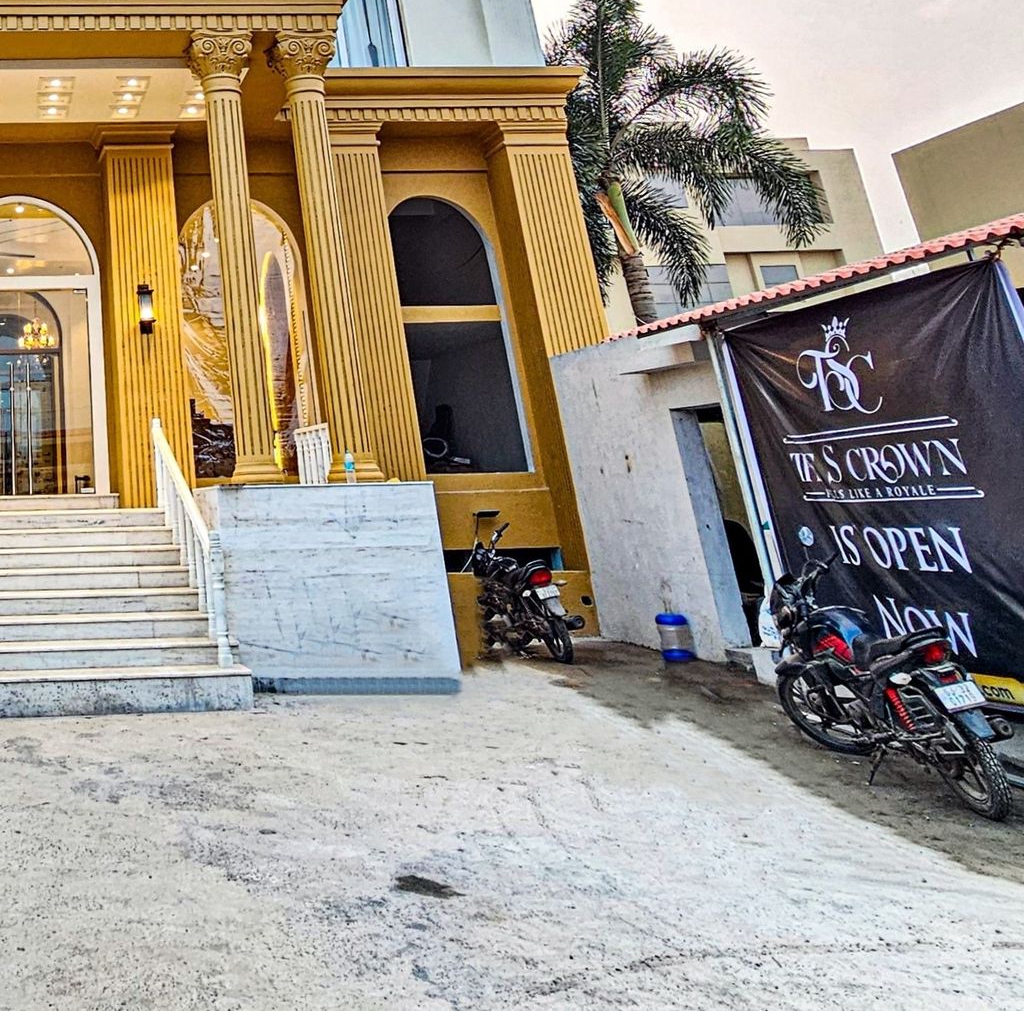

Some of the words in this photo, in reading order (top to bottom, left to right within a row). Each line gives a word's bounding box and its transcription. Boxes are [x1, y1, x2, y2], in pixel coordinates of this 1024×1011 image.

[845, 438, 968, 484] CROWN
[848, 487, 872, 499] LIKE
[875, 487, 883, 498] A
[885, 484, 937, 497] ROYALE
[829, 524, 861, 566] IS
[863, 525, 973, 574] OPEN
[872, 594, 978, 658] NOW
